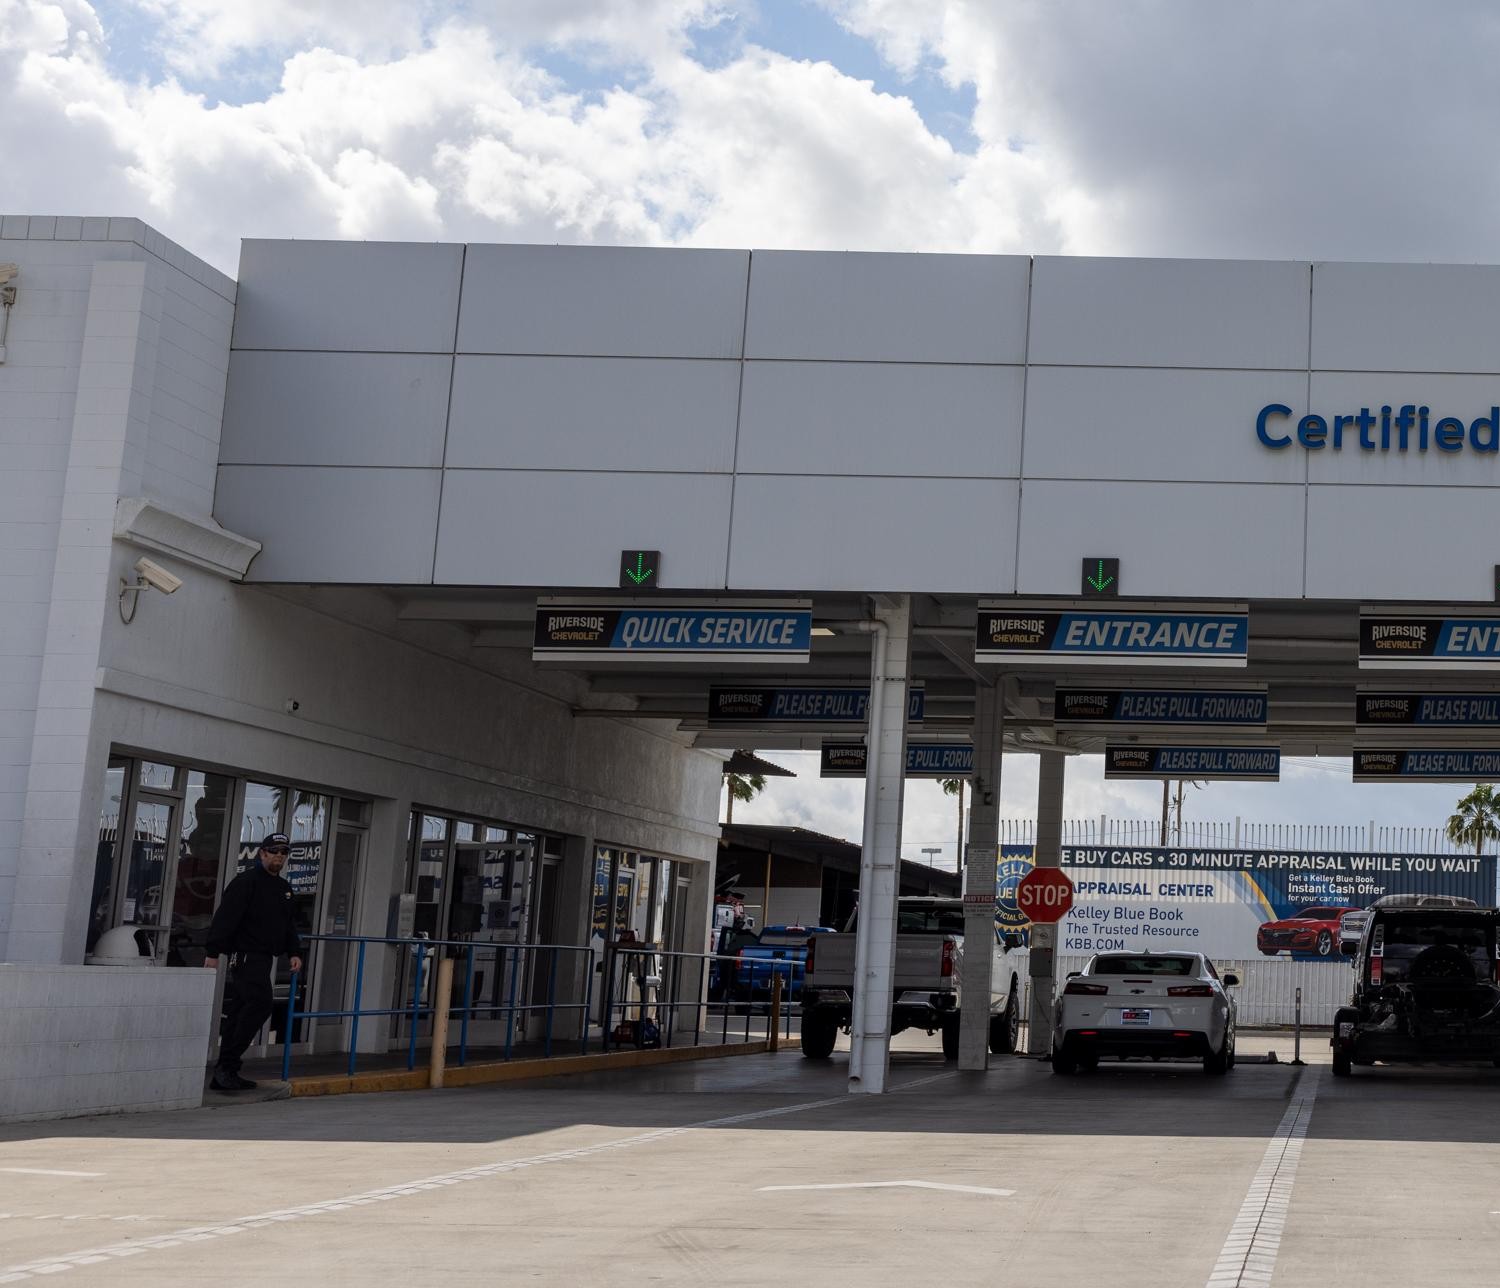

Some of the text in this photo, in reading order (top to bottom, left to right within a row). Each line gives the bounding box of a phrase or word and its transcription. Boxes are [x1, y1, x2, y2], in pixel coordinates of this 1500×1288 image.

[1256, 404, 1499, 451] Certified
[548, 616, 605, 632] RIVERSIDE
[989, 619, 1045, 636] RIVERSIDE
[551, 631, 599, 641] CHEVROLET
[622, 616, 797, 648] QUICK SERVICE
[992, 634, 1040, 644] CHEVROLET
[1064, 620, 1238, 648] ENTRANCE
[1372, 625, 1427, 641] RIVERSIDE
[1375, 639, 1422, 649] CHEVROLET
[719, 694, 763, 707] RIVERSIDE
[775, 694, 822, 715] PLEASE
[824, 695, 854, 716] PULL
[1065, 695, 1108, 708] RIVERSIDE
[1120, 696, 1263, 719] PLEASE PULL FORWARD
[1366, 699, 1408, 712] RIVERSIDE
[1421, 700, 1467, 720] PLEASE
[1468, 700, 1498, 721] PULL
[829, 749, 866, 759] RIVERSIDE
[916, 750, 940, 767] PULL
[942, 751, 975, 768] FORW
[1113, 751, 1149, 761] RIVERSIDE
[1159, 751, 1277, 770] PLEASE PULL FORWARD
[1361, 754, 1397, 765] RIVERSIDE
[1407, 754, 1445, 771] PLEASE
[1446, 754, 1470, 771] PULL
[1061, 850, 1481, 872] E BUY CARS 30 MINUTE APPRAISAL WHILE YOU WAIT
[1288, 874, 1302, 882] Get
[1310, 874, 1334, 883] Kelley
[1336, 875, 1354, 883] Blue
[1355, 875, 1375, 883] Book
[1022, 884, 1069, 906] STOP
[1159, 884, 1214, 897] CENTER
[1288, 883, 1386, 895] Instant Cash Offer
[965, 895, 995, 903] NOTICE
[1288, 894, 1299, 902] for
[1068, 906, 1183, 922] Kelley Blue Book
[1066, 923, 1199, 937] The Trusted Resource
[1065, 938, 1124, 950] KBB.COM
